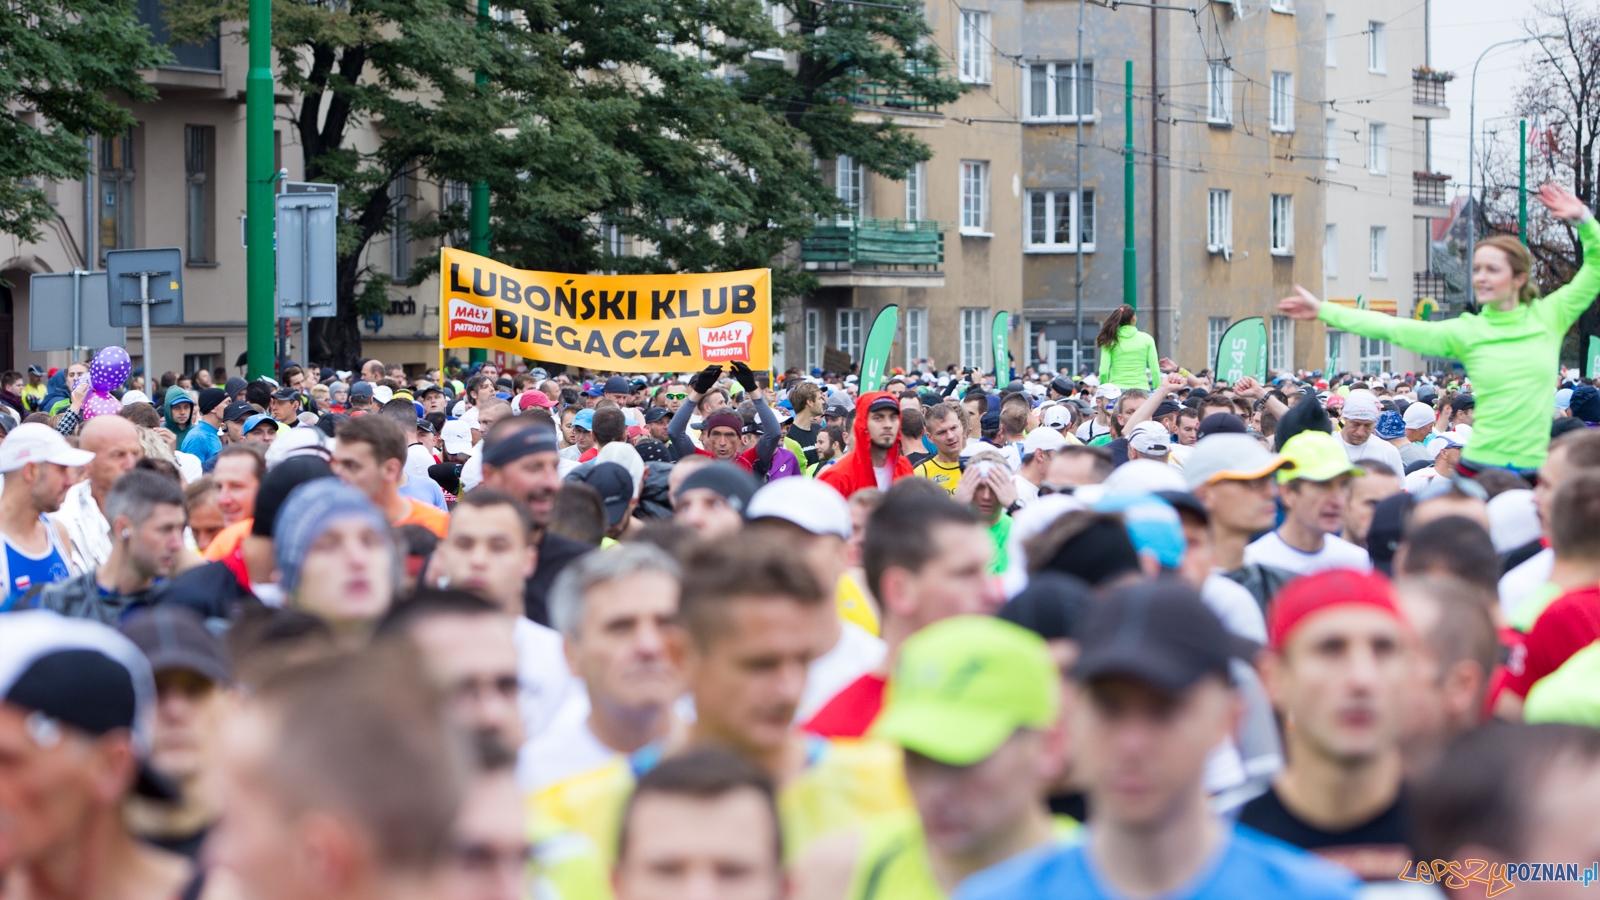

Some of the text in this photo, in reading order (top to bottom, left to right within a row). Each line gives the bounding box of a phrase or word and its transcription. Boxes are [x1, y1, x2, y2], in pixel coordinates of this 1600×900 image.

[451, 262, 757, 320] LUBOŃSKI KLUB
[455, 306, 488, 320] MAŁY
[454, 322, 490, 334] PATRIOTA
[495, 309, 692, 359] BIEGACZA
[707, 329, 742, 343] MAŁY
[706, 346, 743, 357] PATRIOTA
[1228, 337, 1248, 383] 3:45
